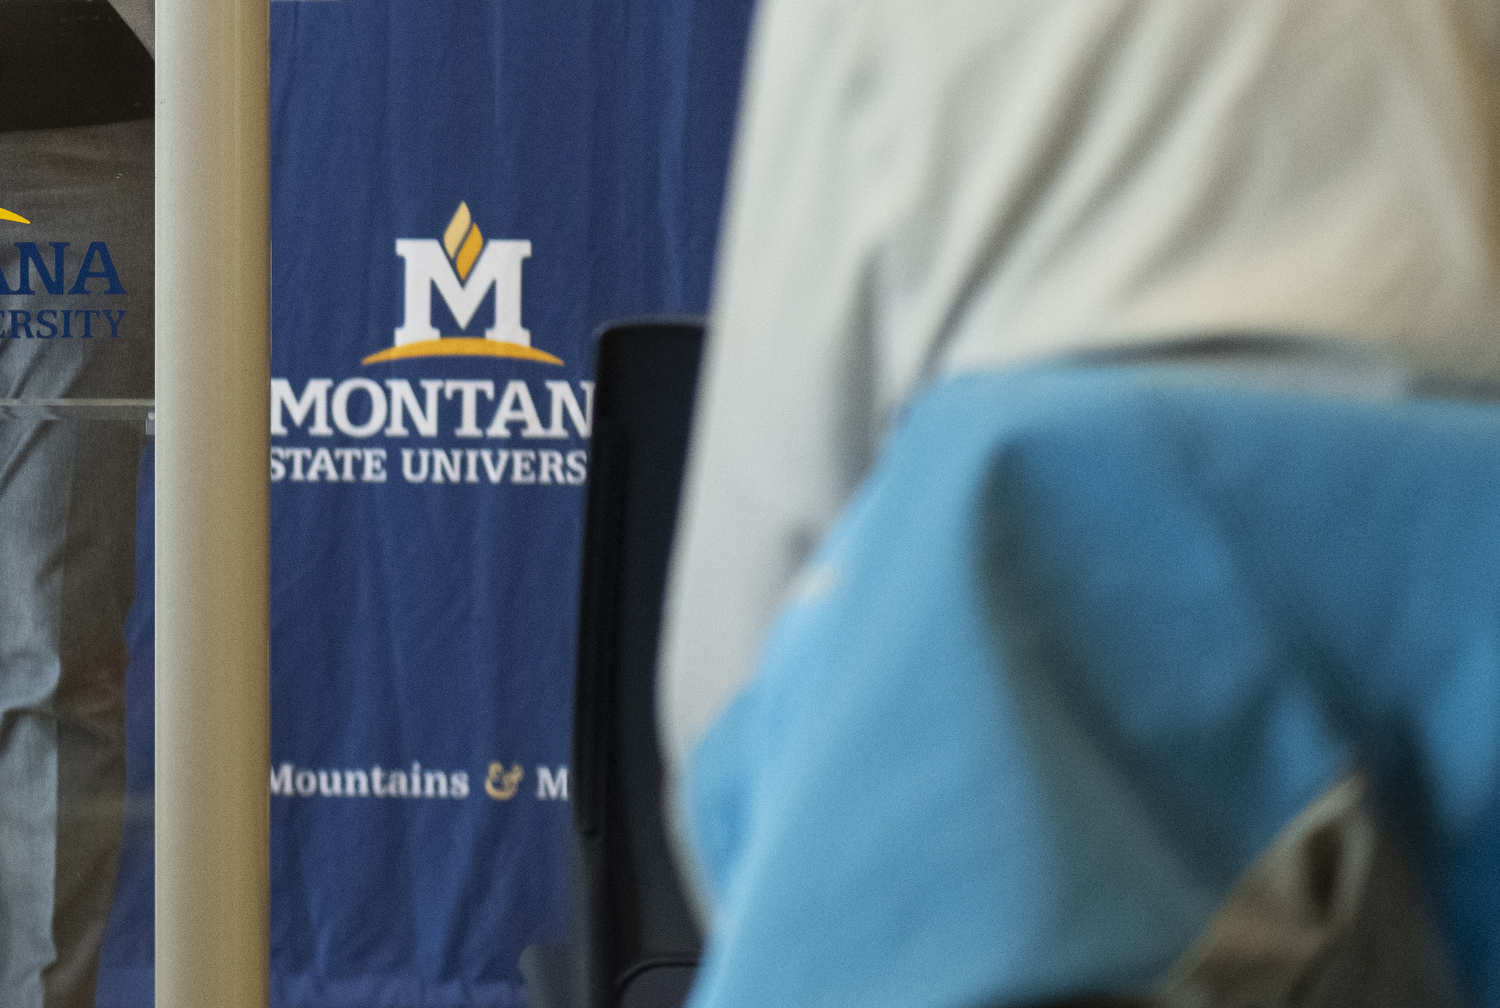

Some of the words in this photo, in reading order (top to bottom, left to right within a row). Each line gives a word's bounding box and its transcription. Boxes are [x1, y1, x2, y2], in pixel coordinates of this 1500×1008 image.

[394, 239, 532, 348] M
[271, 378, 593, 437] MONTAN
[271, 448, 386, 481] STATE
[402, 450, 586, 483] UNIVERS
[485, 762, 523, 799] &
